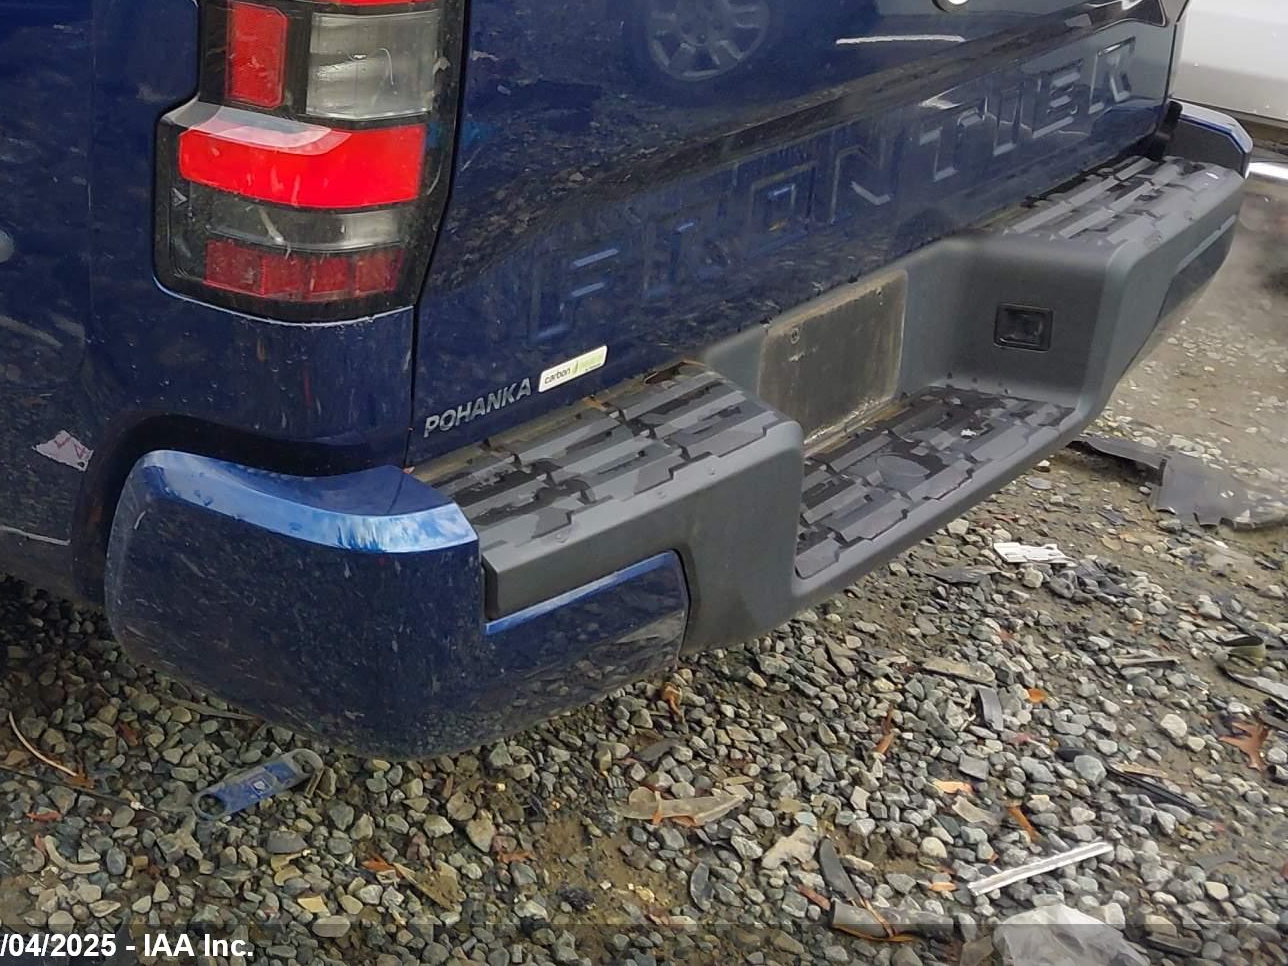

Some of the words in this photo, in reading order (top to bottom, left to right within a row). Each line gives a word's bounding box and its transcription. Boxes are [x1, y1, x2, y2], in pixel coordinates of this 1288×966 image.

[528, 37, 1136, 341] FRONTIER
[544, 367, 571, 384] carbon
[423, 378, 532, 438] POHANKA
